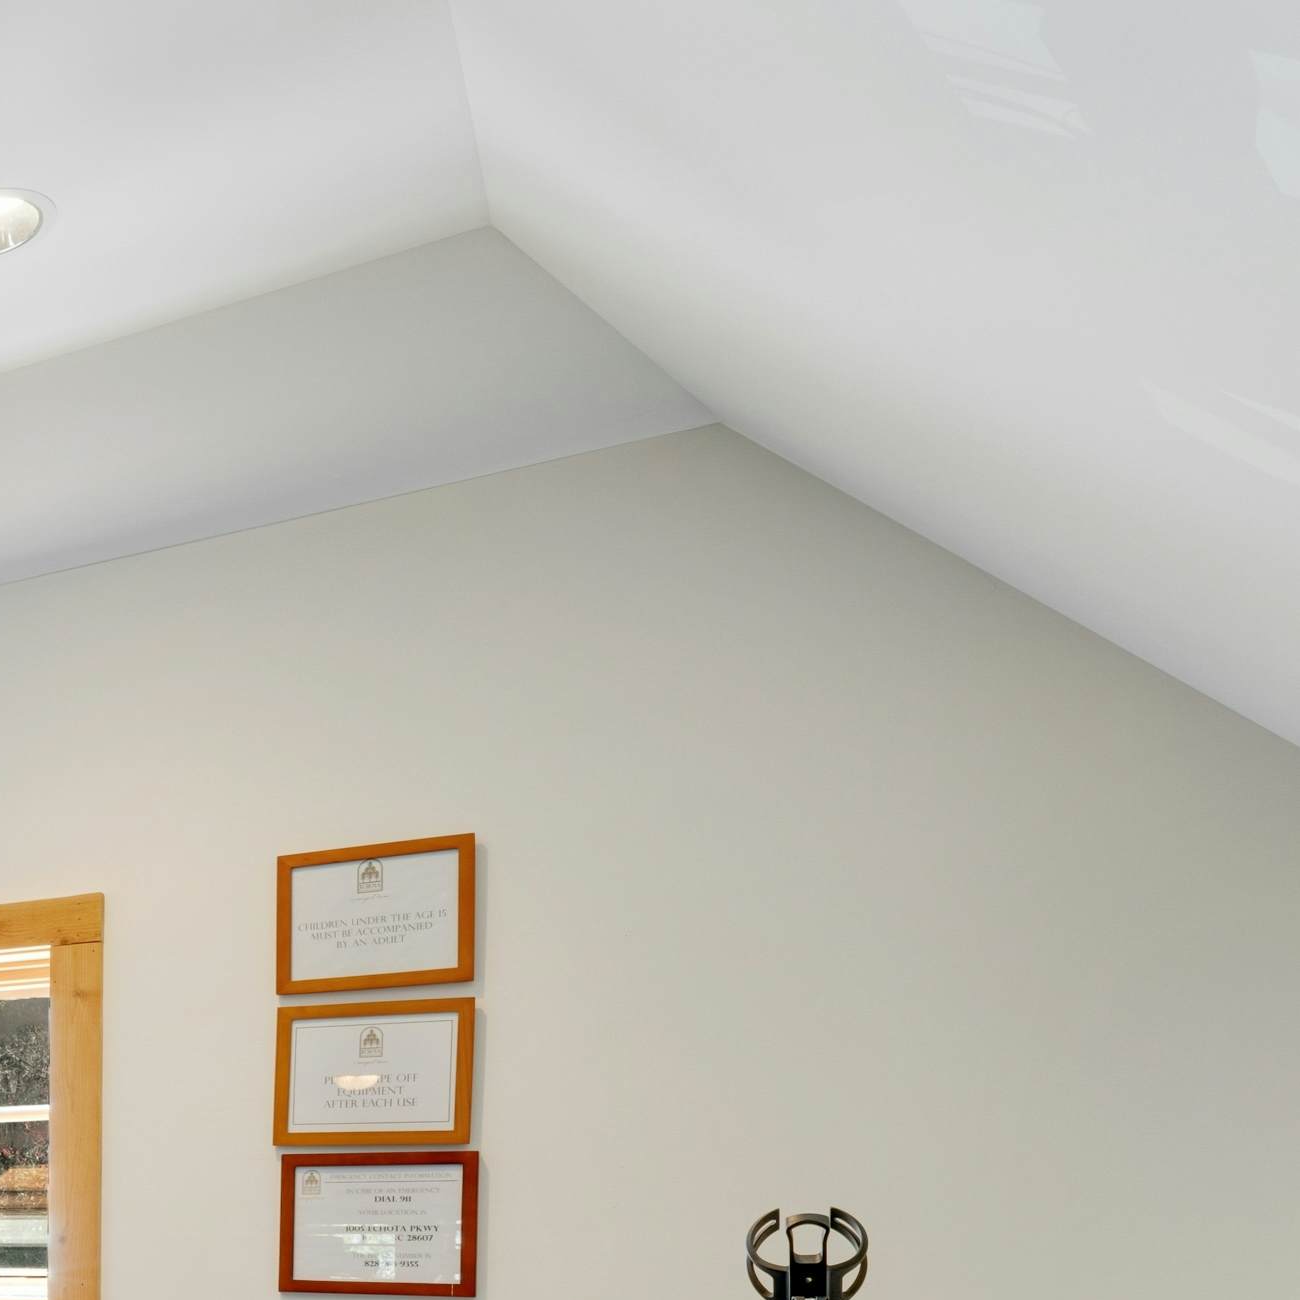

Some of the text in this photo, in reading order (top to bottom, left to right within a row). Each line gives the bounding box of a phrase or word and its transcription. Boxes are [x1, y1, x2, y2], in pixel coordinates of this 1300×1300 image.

[298, 908, 448, 931] CHILDREN UNDER THE AGE 15
[311, 921, 433, 941] MUST BE ACCOMPANIED
[336, 934, 407, 949] BY AN ADULT
[396, 1073, 418, 1083] OFF
[337, 1086, 403, 1097] EQUIPMENT
[325, 1096, 417, 1109] AFTER EACH USE
[410, 1224, 440, 1233] PKWY
[407, 1234, 434, 1242] 28607
